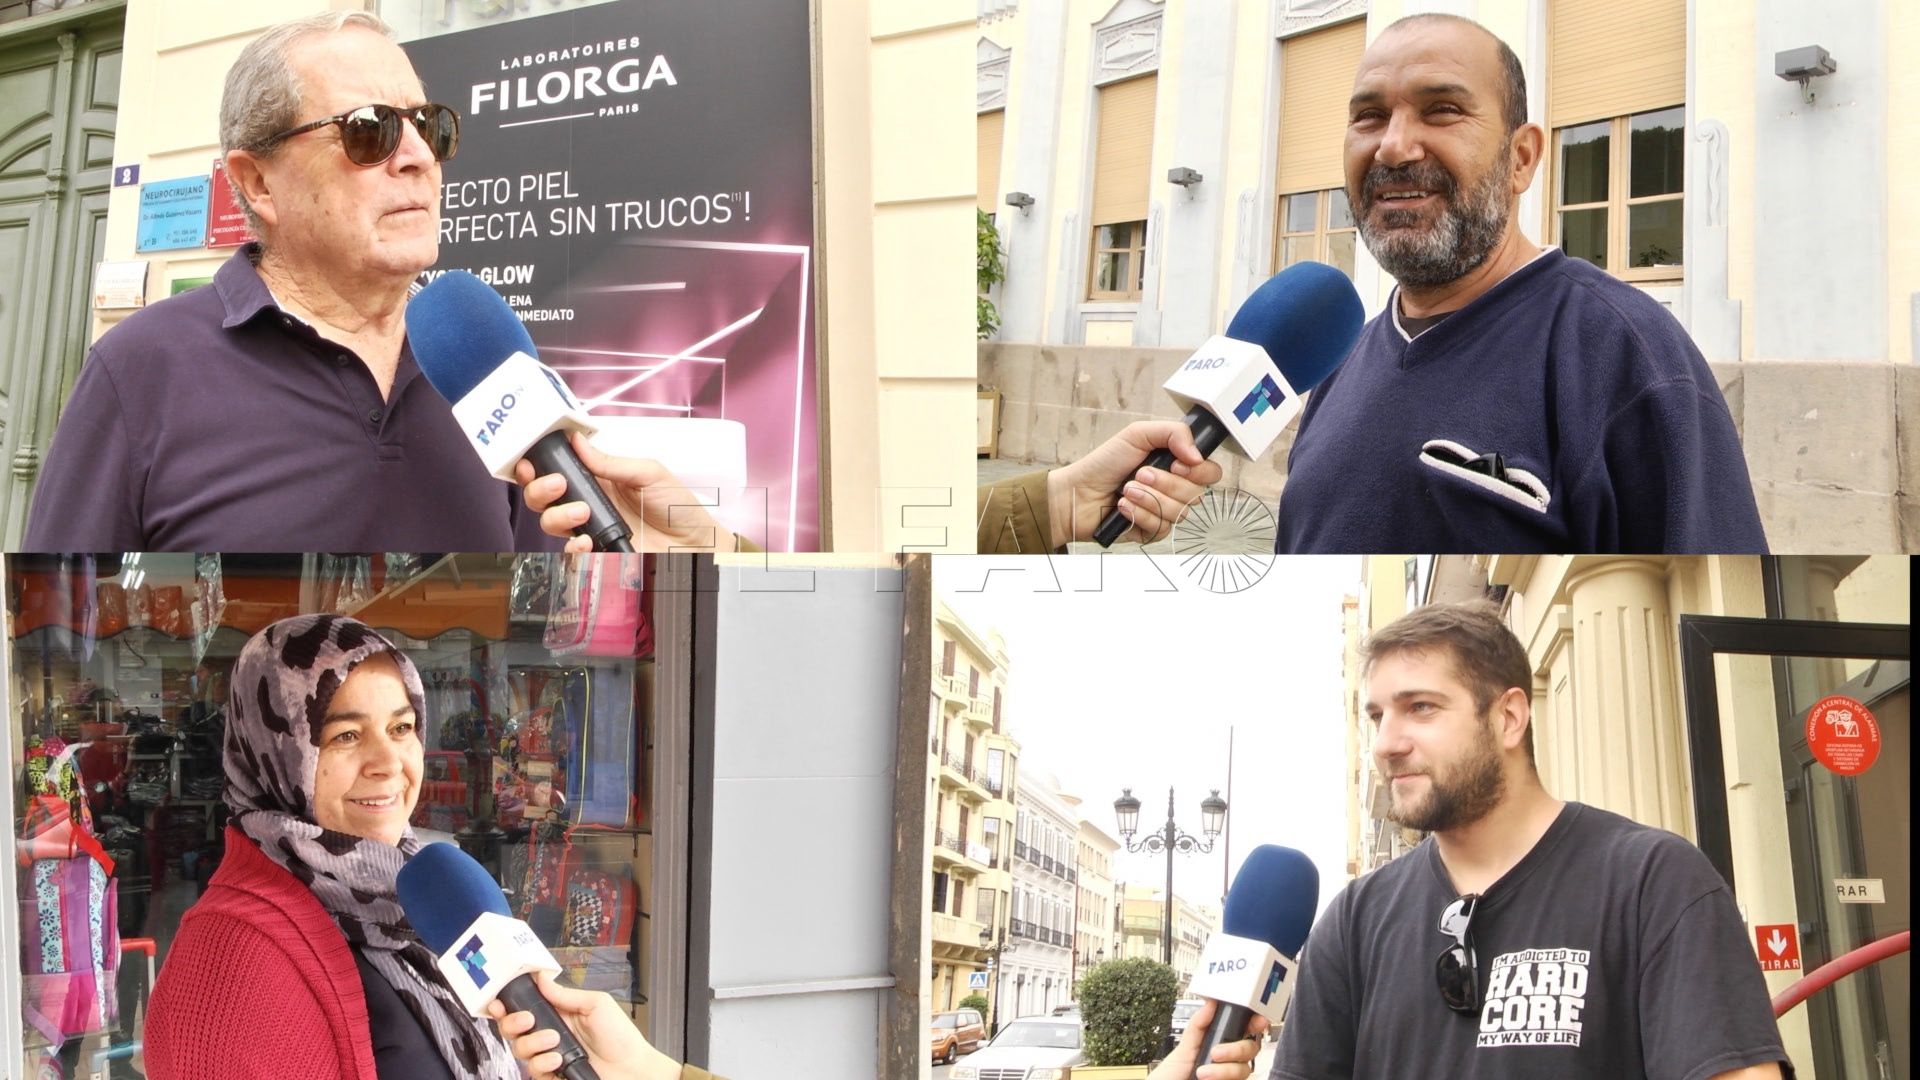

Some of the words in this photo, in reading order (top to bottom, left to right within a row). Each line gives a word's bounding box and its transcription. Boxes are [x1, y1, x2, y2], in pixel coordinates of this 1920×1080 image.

[500, 36, 641, 71] LABORATOIRES
[470, 54, 678, 115] FILORGA
[599, 103, 639, 118] PARIS
[440, 177, 510, 210] ECTO
[519, 170, 579, 202] PIEL
[438, 210, 538, 244] RFECTA
[549, 205, 596, 237] SIN
[514, 309, 575, 322] NMEDIATO
[1510, 950, 1567, 965] ADDICTED
[1570, 951, 1587, 963] TO
[1759, 958, 1800, 970] TIRAR
[1485, 962, 1589, 1002] HARD
[1480, 995, 1585, 1033] CORE
[1479, 1034, 1498, 1045] MY
[1501, 1032, 1533, 1043] WAY
[1535, 1032, 1550, 1042] OF
[1554, 1032, 1579, 1045] LIFE
